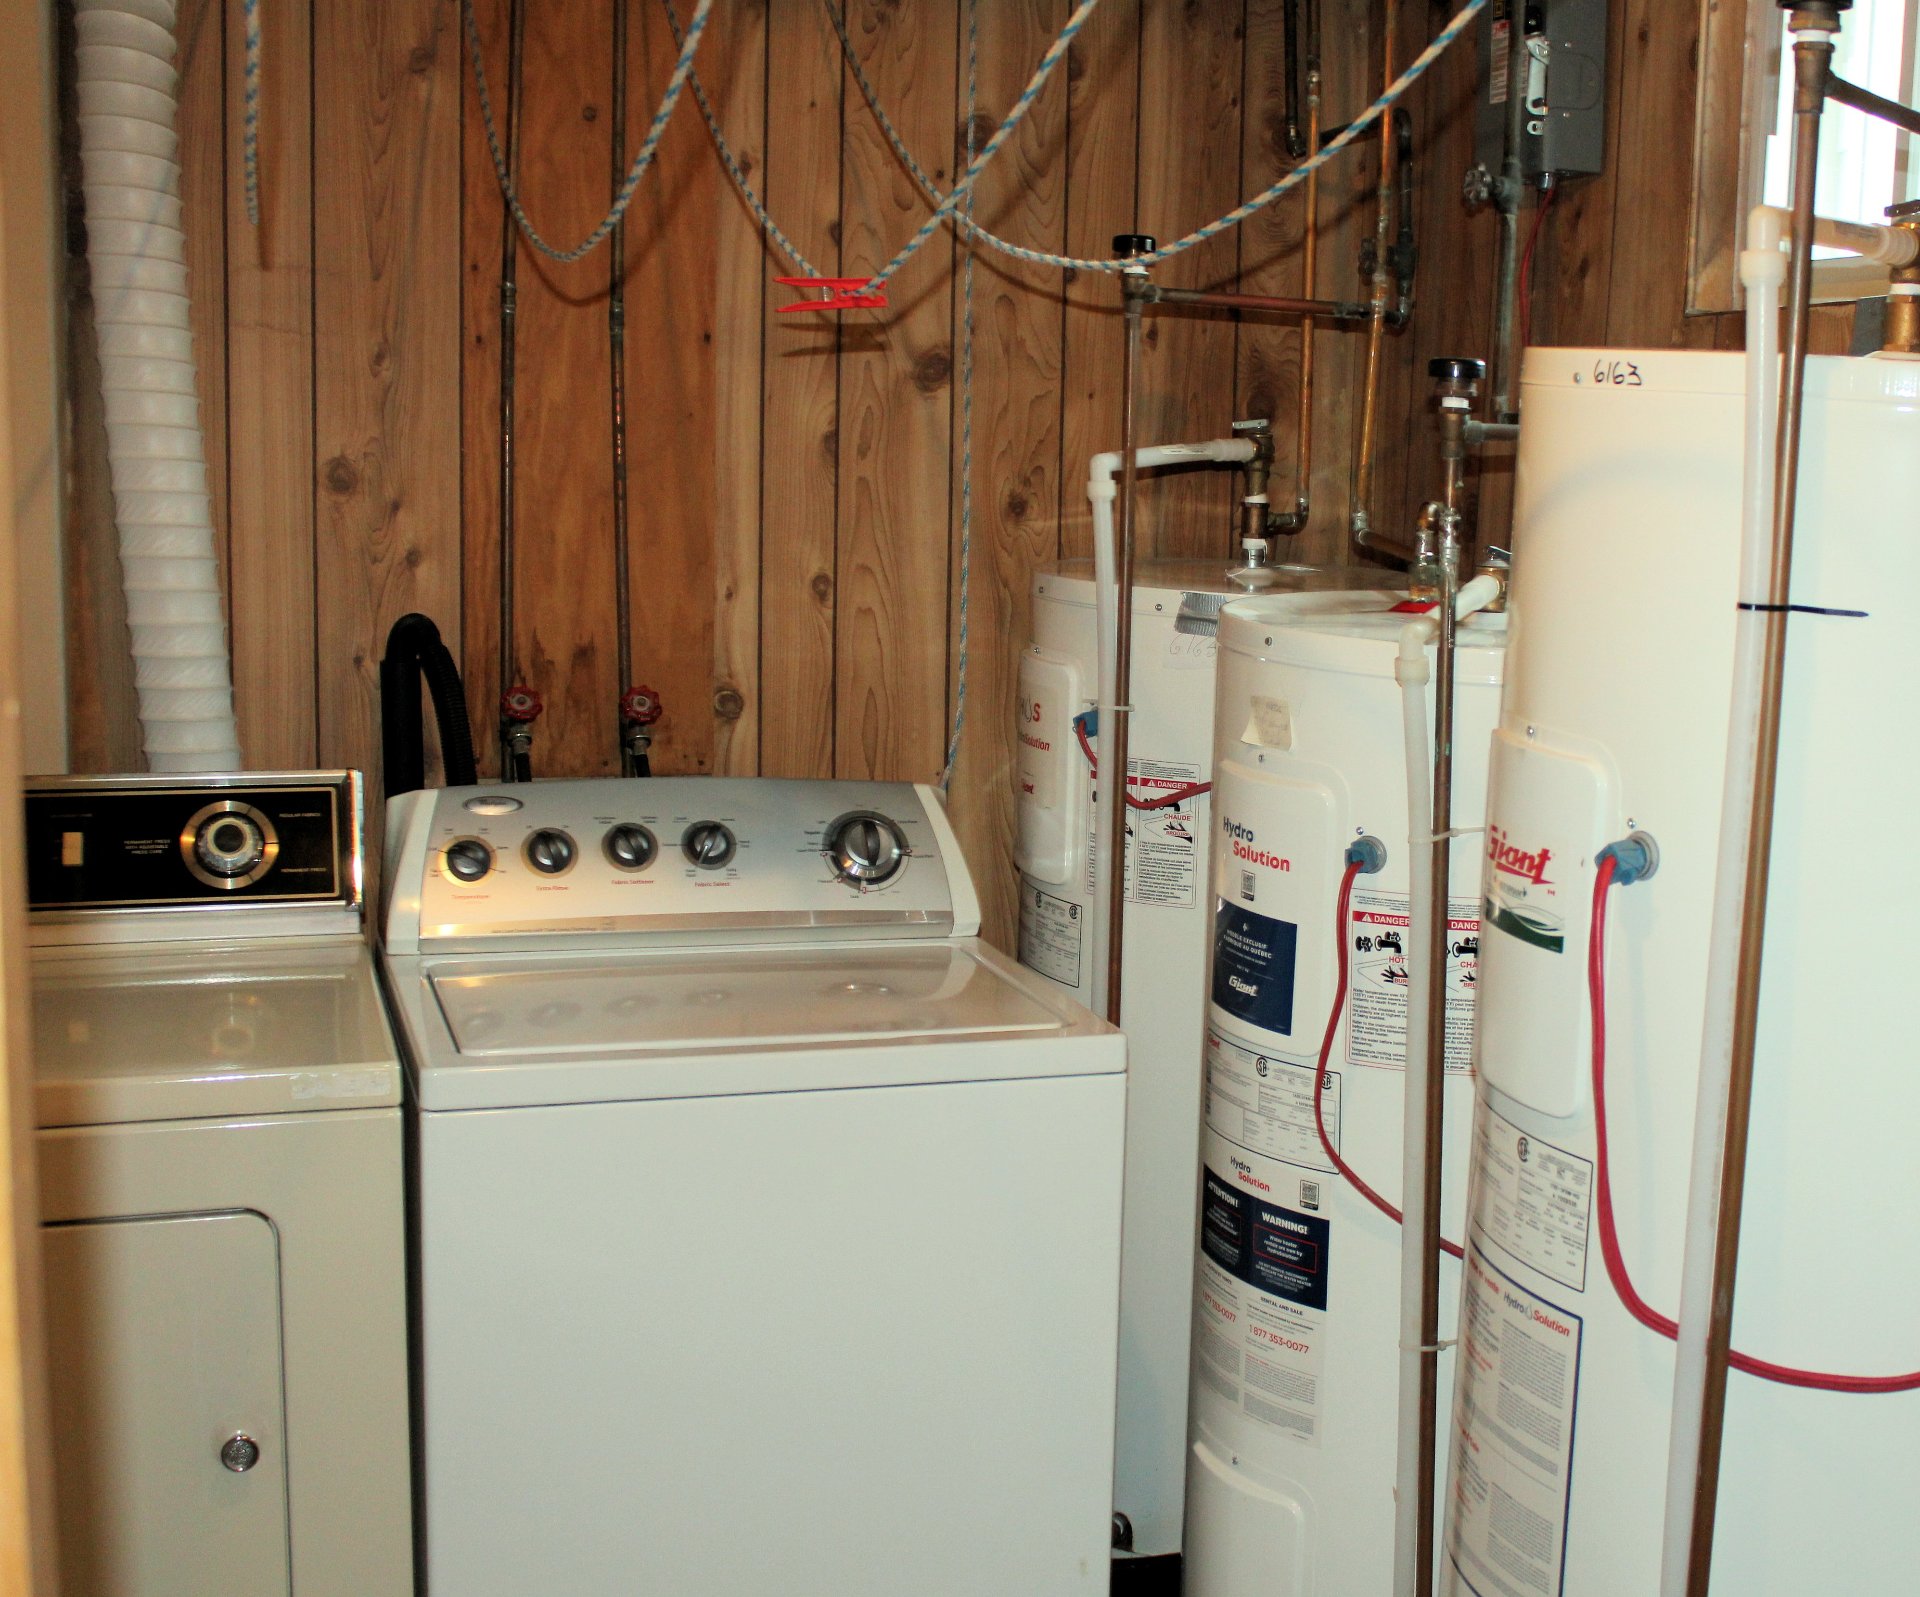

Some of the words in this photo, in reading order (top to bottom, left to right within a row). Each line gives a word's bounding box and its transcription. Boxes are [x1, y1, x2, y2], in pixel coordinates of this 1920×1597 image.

[1594, 359, 1642, 386] 6163
[1157, 780, 1188, 790] DANGER
[1163, 813, 1192, 821] CHAUDE
[1223, 816, 1254, 842] Hydro
[1232, 839, 1291, 872] Solution
[1451, 920, 1478, 932] DANG
[1388, 956, 1406, 964] HOT
[1460, 961, 1478, 969] CHA
[1229, 975, 1257, 997] Giant
[1230, 1156, 1251, 1173] Hydro
[1238, 1171, 1270, 1193] Solution
[1262, 1211, 1309, 1235] WARNING!
[1260, 1296, 1278, 1307] RENTAL
[1290, 1307, 1304, 1316] SALE
[1503, 1290, 1525, 1314] Hydro
[1532, 1308, 1570, 1337] Solution
[1253, 1326, 1267, 1338] 877
[1268, 1333, 1310, 1354] 353-0077
